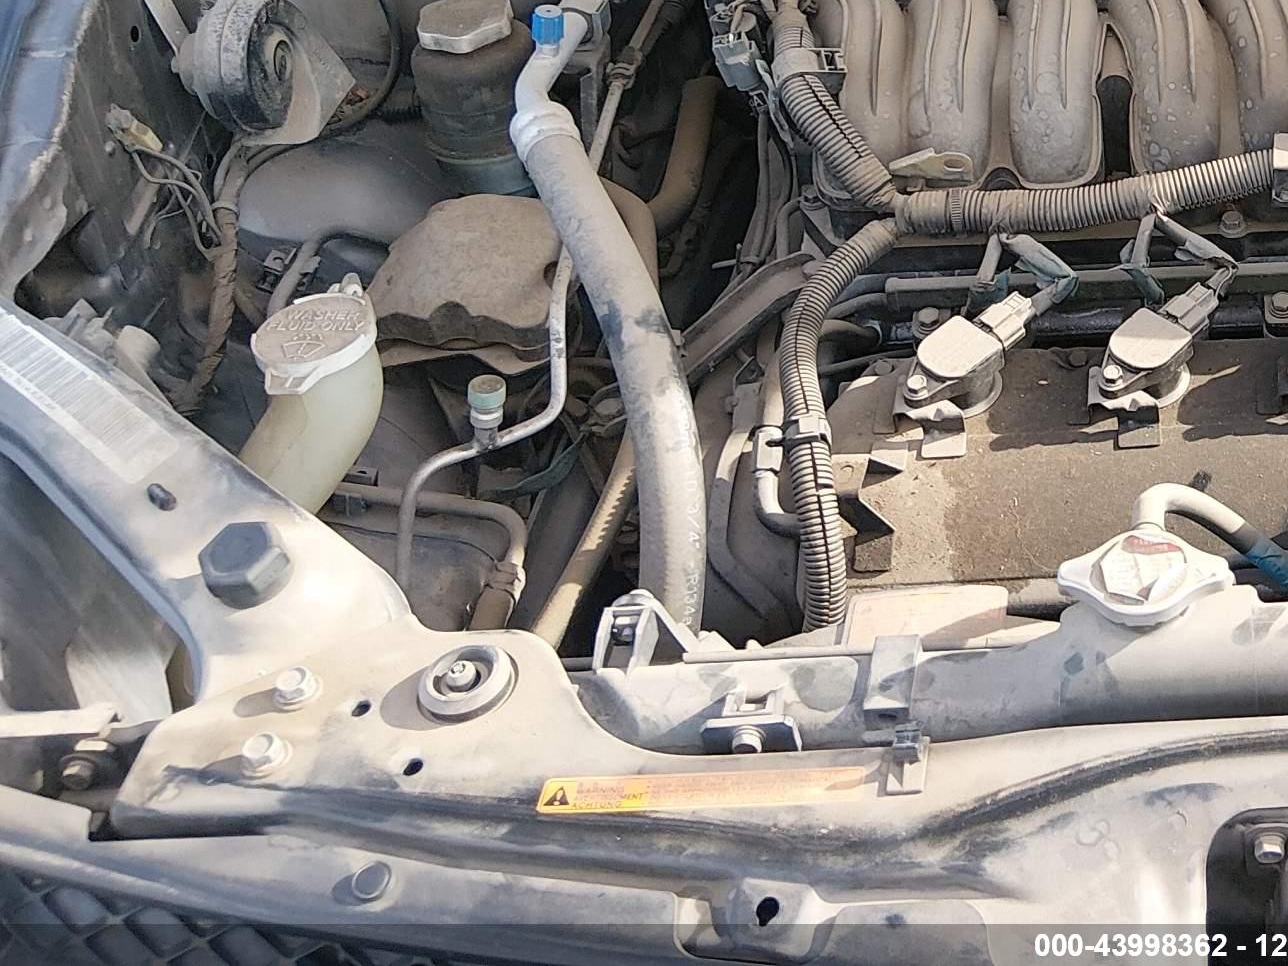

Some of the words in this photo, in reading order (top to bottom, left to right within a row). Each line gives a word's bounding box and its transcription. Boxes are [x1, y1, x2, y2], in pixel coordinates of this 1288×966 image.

[286, 308, 361, 321] WASHER
[266, 320, 315, 332] FLUID
[320, 320, 365, 332] ONLY
[576, 786, 625, 795] WARNING
[571, 800, 622, 811] ACHTUNG
